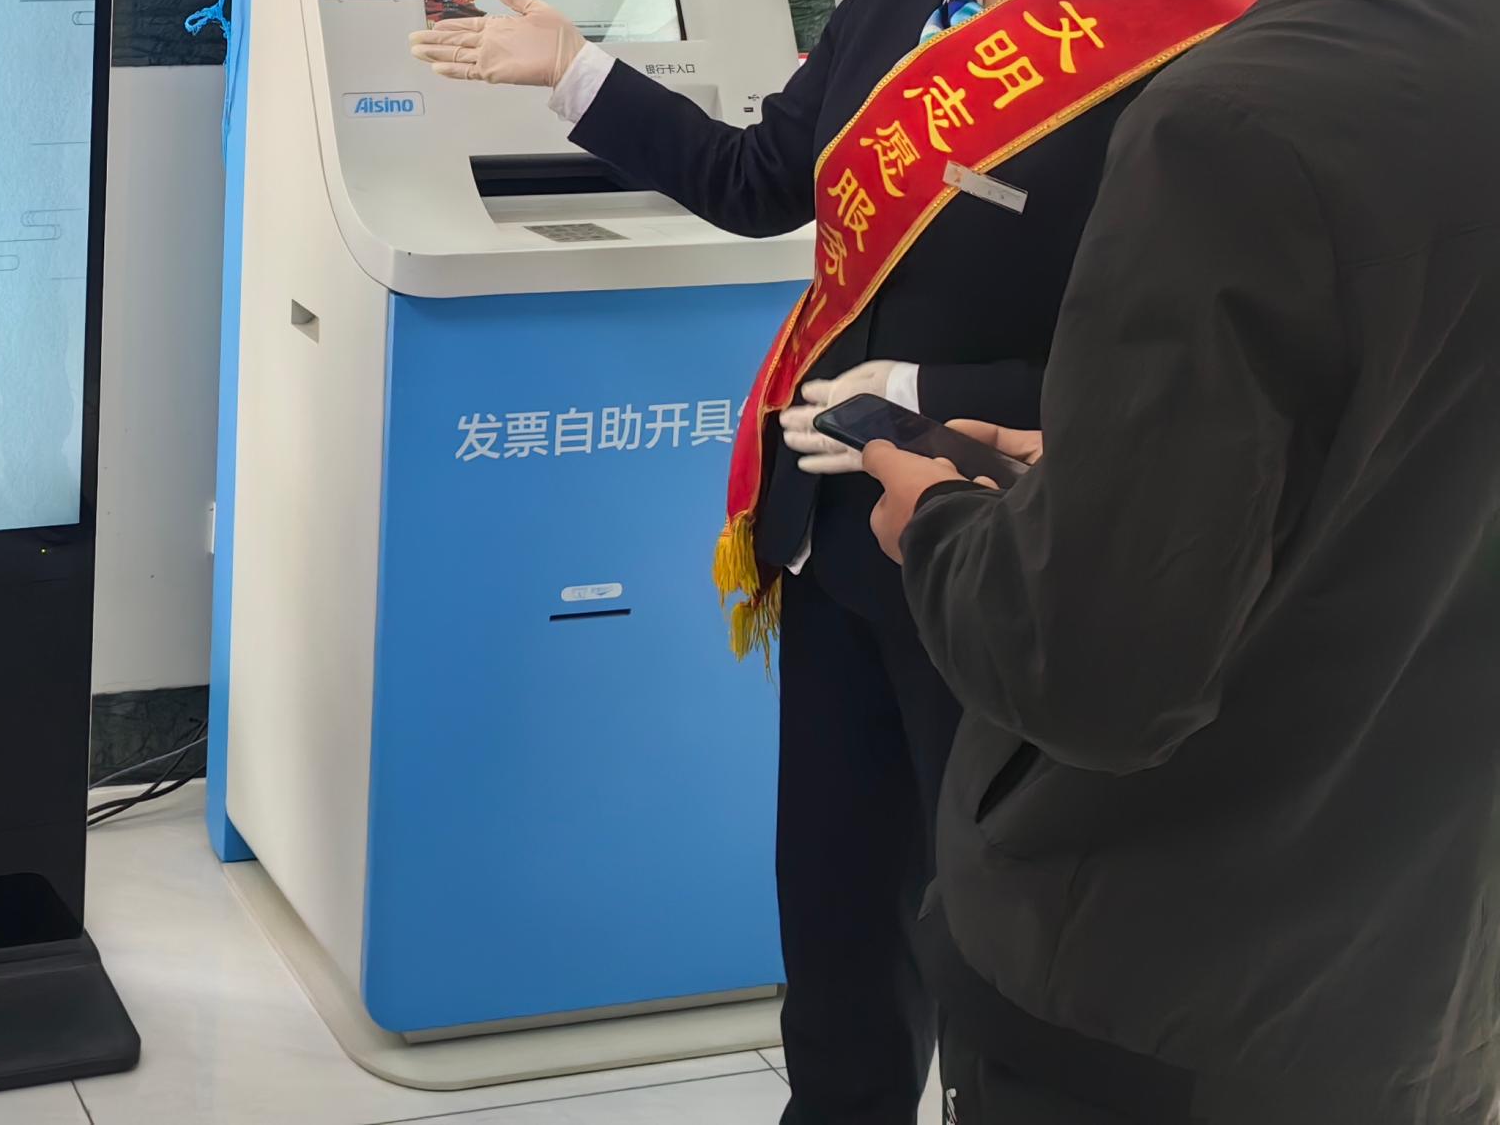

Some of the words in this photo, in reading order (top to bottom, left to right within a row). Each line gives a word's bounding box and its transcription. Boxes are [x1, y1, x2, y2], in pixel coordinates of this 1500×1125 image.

[645, 63, 696, 75] 银行卡入口
[354, 96, 414, 115] Aisino
[807, 0, 1105, 327] 文明志愿服务
[454, 397, 749, 462] 发票自助开具
